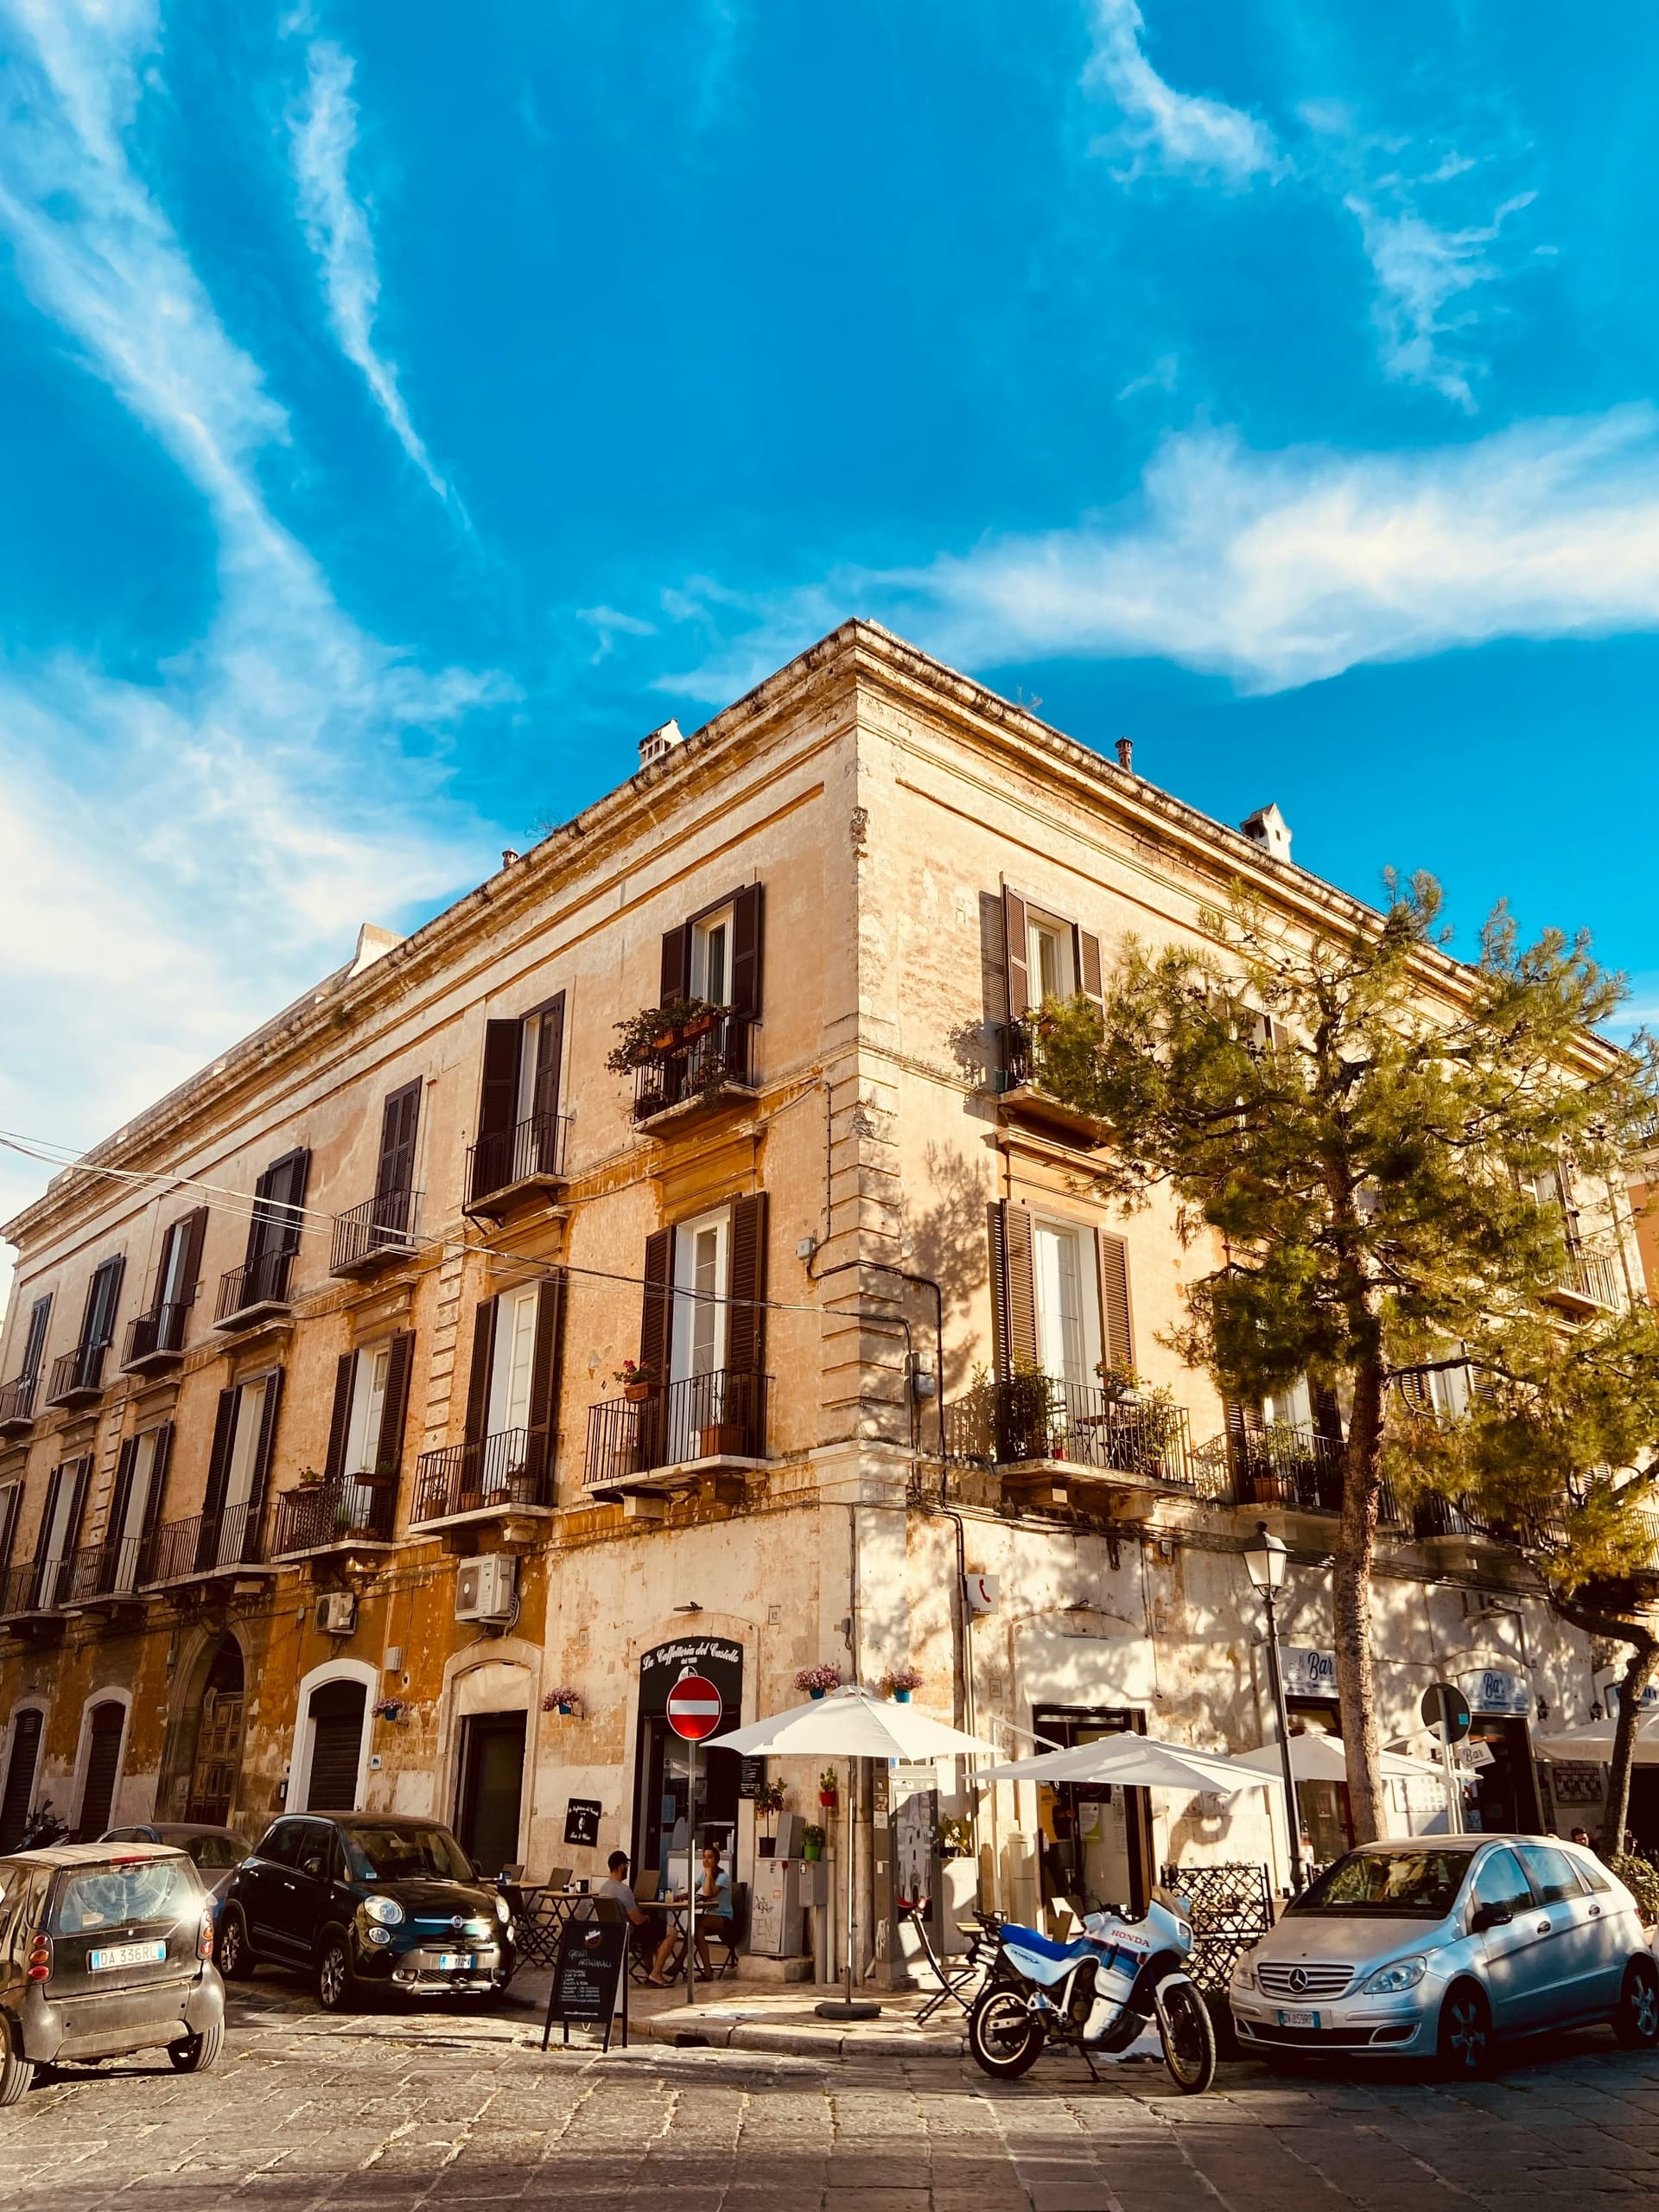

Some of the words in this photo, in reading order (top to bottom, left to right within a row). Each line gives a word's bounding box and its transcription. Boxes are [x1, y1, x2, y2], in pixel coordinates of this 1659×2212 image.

[642, 1655, 655, 1671] La
[657, 1644, 695, 1666] Caffetteria
[695, 1642, 709, 1656] del
[710, 1643, 740, 1663] Castello
[1307, 1651, 1334, 1681] Bar
[1462, 1747, 1484, 1763] Bar
[1110, 1929, 1151, 1948] HONDA
[100, 1952, 116, 1967] DA
[119, 1945, 156, 1964] 336RL
